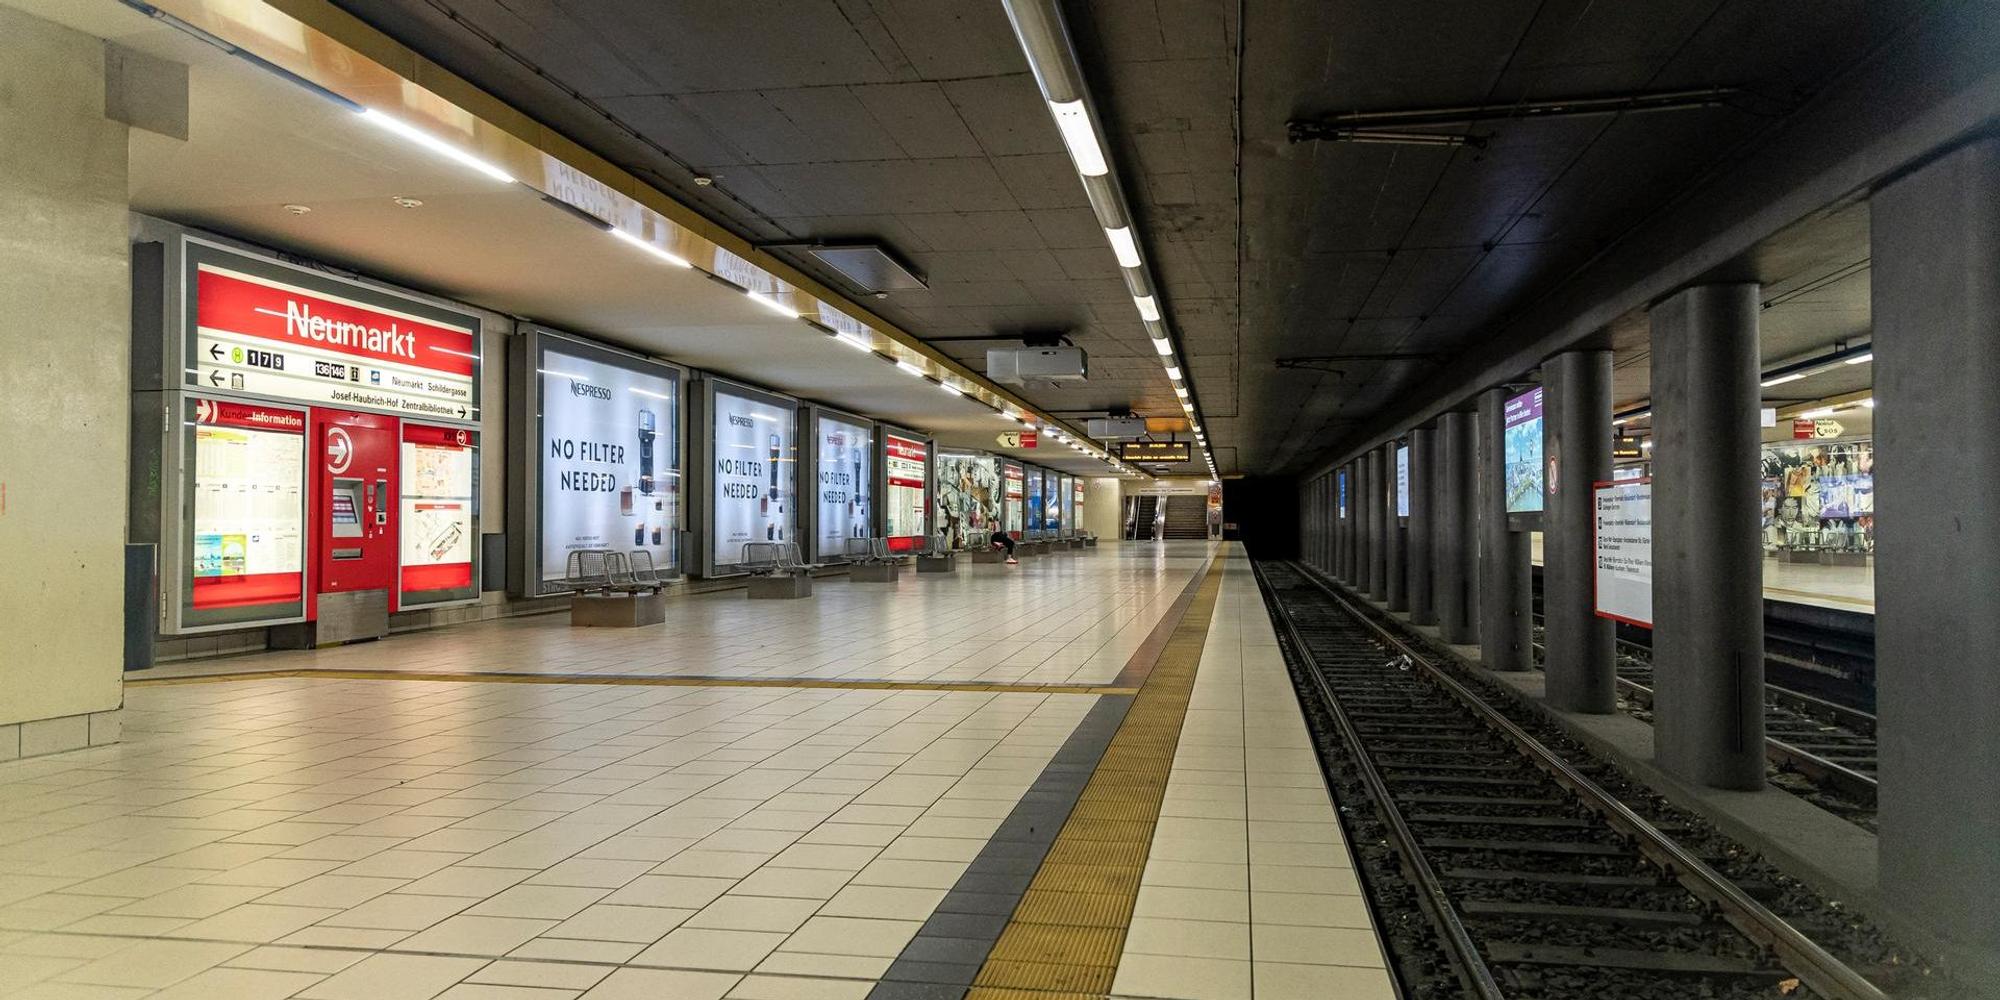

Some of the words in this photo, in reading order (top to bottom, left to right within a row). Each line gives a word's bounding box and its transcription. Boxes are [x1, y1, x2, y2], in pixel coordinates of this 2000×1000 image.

[287, 300, 416, 359] Neumarkt
[315, 362, 329, 375] 136
[331, 365, 344, 378] 146
[392, 376, 423, 390] Neumarkt
[428, 382, 467, 397] Schildergasse
[570, 377, 612, 401] NESPRESSO
[331, 389, 398, 407] Josef-Haubrich-Hof
[402, 399, 454, 415] Zentralbibliothek
[729, 412, 754, 428] NESPRESSO
[551, 437, 574, 460] NO
[581, 441, 625, 465] FILTER
[718, 459, 732, 474] NO
[735, 460, 763, 478] FILTER
[819, 472, 830, 484] NO
[831, 472, 850, 486] FILTER
[561, 471, 616, 493] NEEDED
[723, 483, 758, 499] NEEDED
[823, 491, 847, 504] NEEDED
